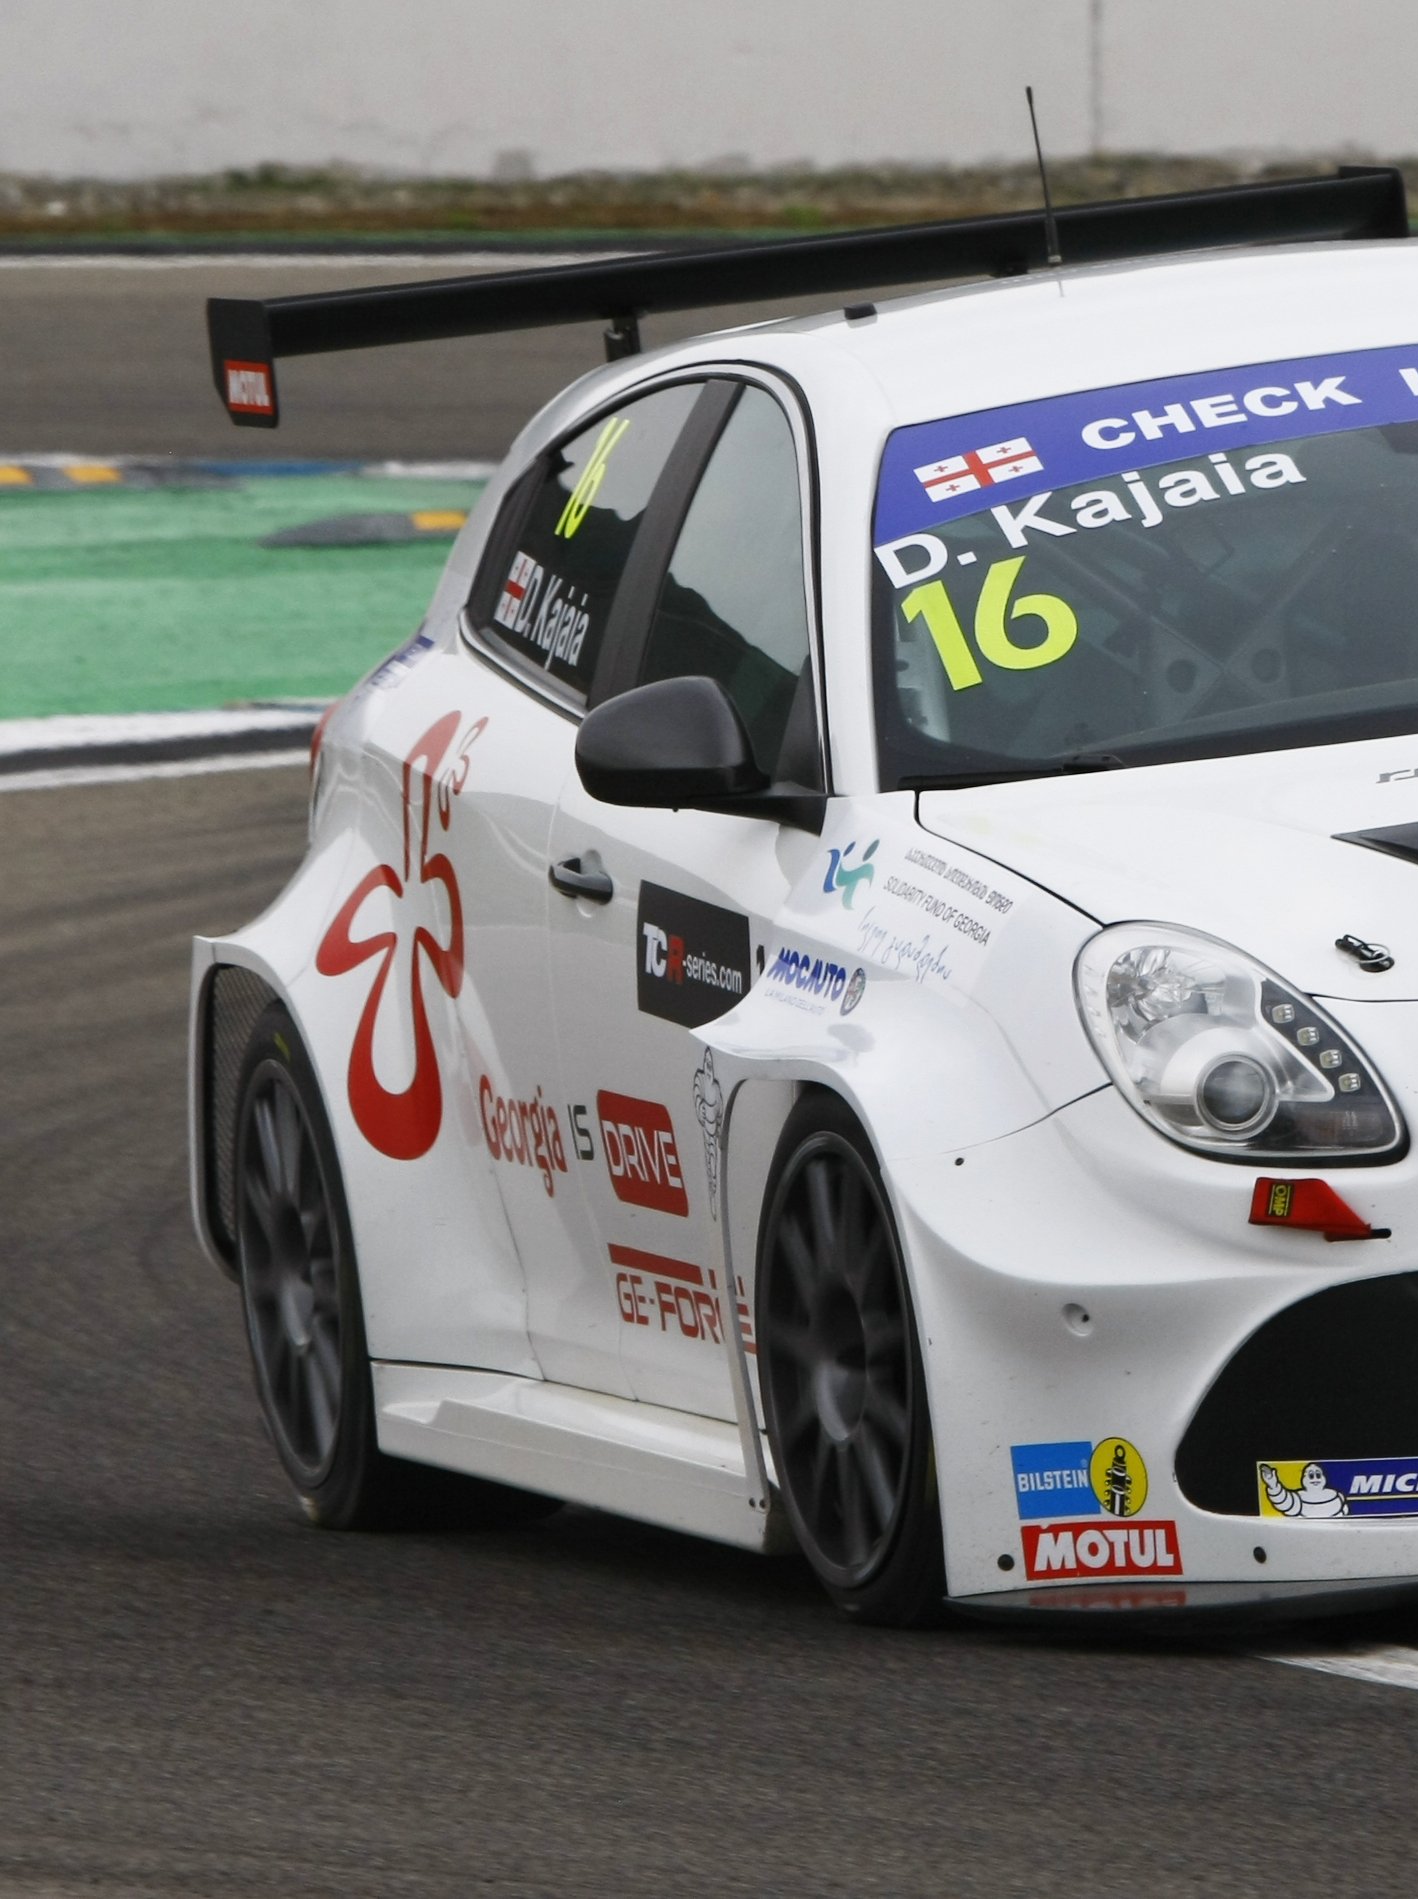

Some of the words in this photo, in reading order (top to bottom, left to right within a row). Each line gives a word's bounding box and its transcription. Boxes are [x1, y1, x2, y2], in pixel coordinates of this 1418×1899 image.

[1081, 375, 1363, 450] CHECK
[554, 416, 630, 539] 16
[873, 532, 978, 589] D.
[990, 451, 1307, 549] Kajaia
[530, 573, 590, 672] Kajaia
[900, 555, 1079, 691] 16
[922, 894, 946, 917] FUND
[941, 906, 958, 923] OF
[953, 913, 991, 946] GEORGIA
[641, 921, 743, 995] TCR-series.com
[766, 946, 847, 1001] MOCAUTO
[479, 1074, 569, 1199] Georgia
[567, 1103, 595, 1161] IS
[600, 1119, 684, 1189] DRIVE
[1017, 1468, 1090, 1493] BILSTEIN
[1033, 1529, 1175, 1572] MOTUL
